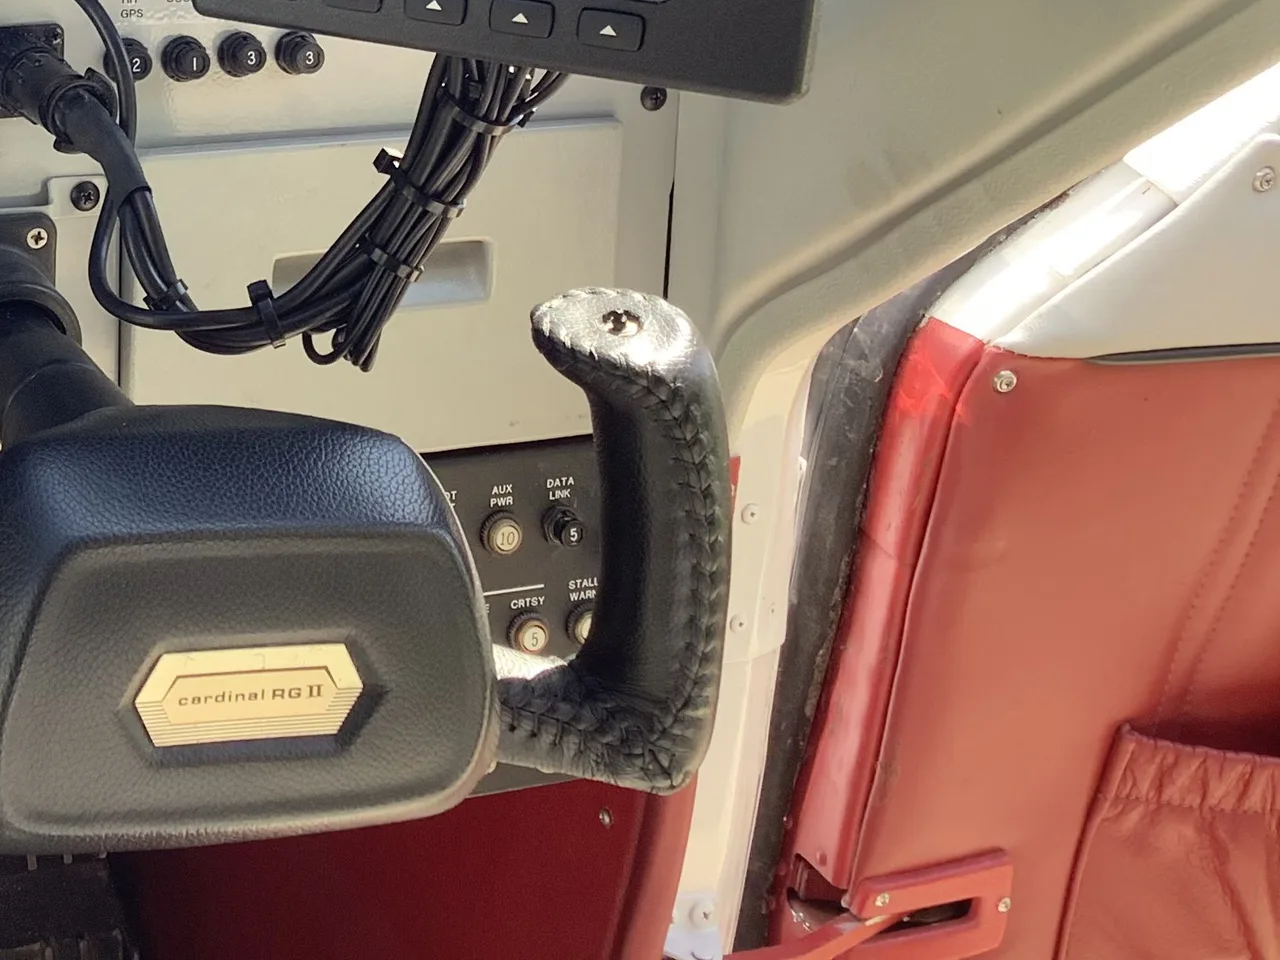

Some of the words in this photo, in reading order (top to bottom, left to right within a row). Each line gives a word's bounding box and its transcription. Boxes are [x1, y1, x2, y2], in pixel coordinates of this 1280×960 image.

[121, 9, 143, 18] GPS
[248, 51, 256, 65] 3
[306, 51, 314, 65] 3
[547, 477, 574, 488] DATA
[492, 484, 513, 495] AUX
[550, 489, 571, 500] LINK
[490, 497, 513, 508] PWR
[500, 532, 514, 545] 10
[570, 528, 578, 541] 5
[511, 596, 545, 609] CRTSY
[178, 689, 265, 706] cardinal
[272, 687, 301, 700] RG
